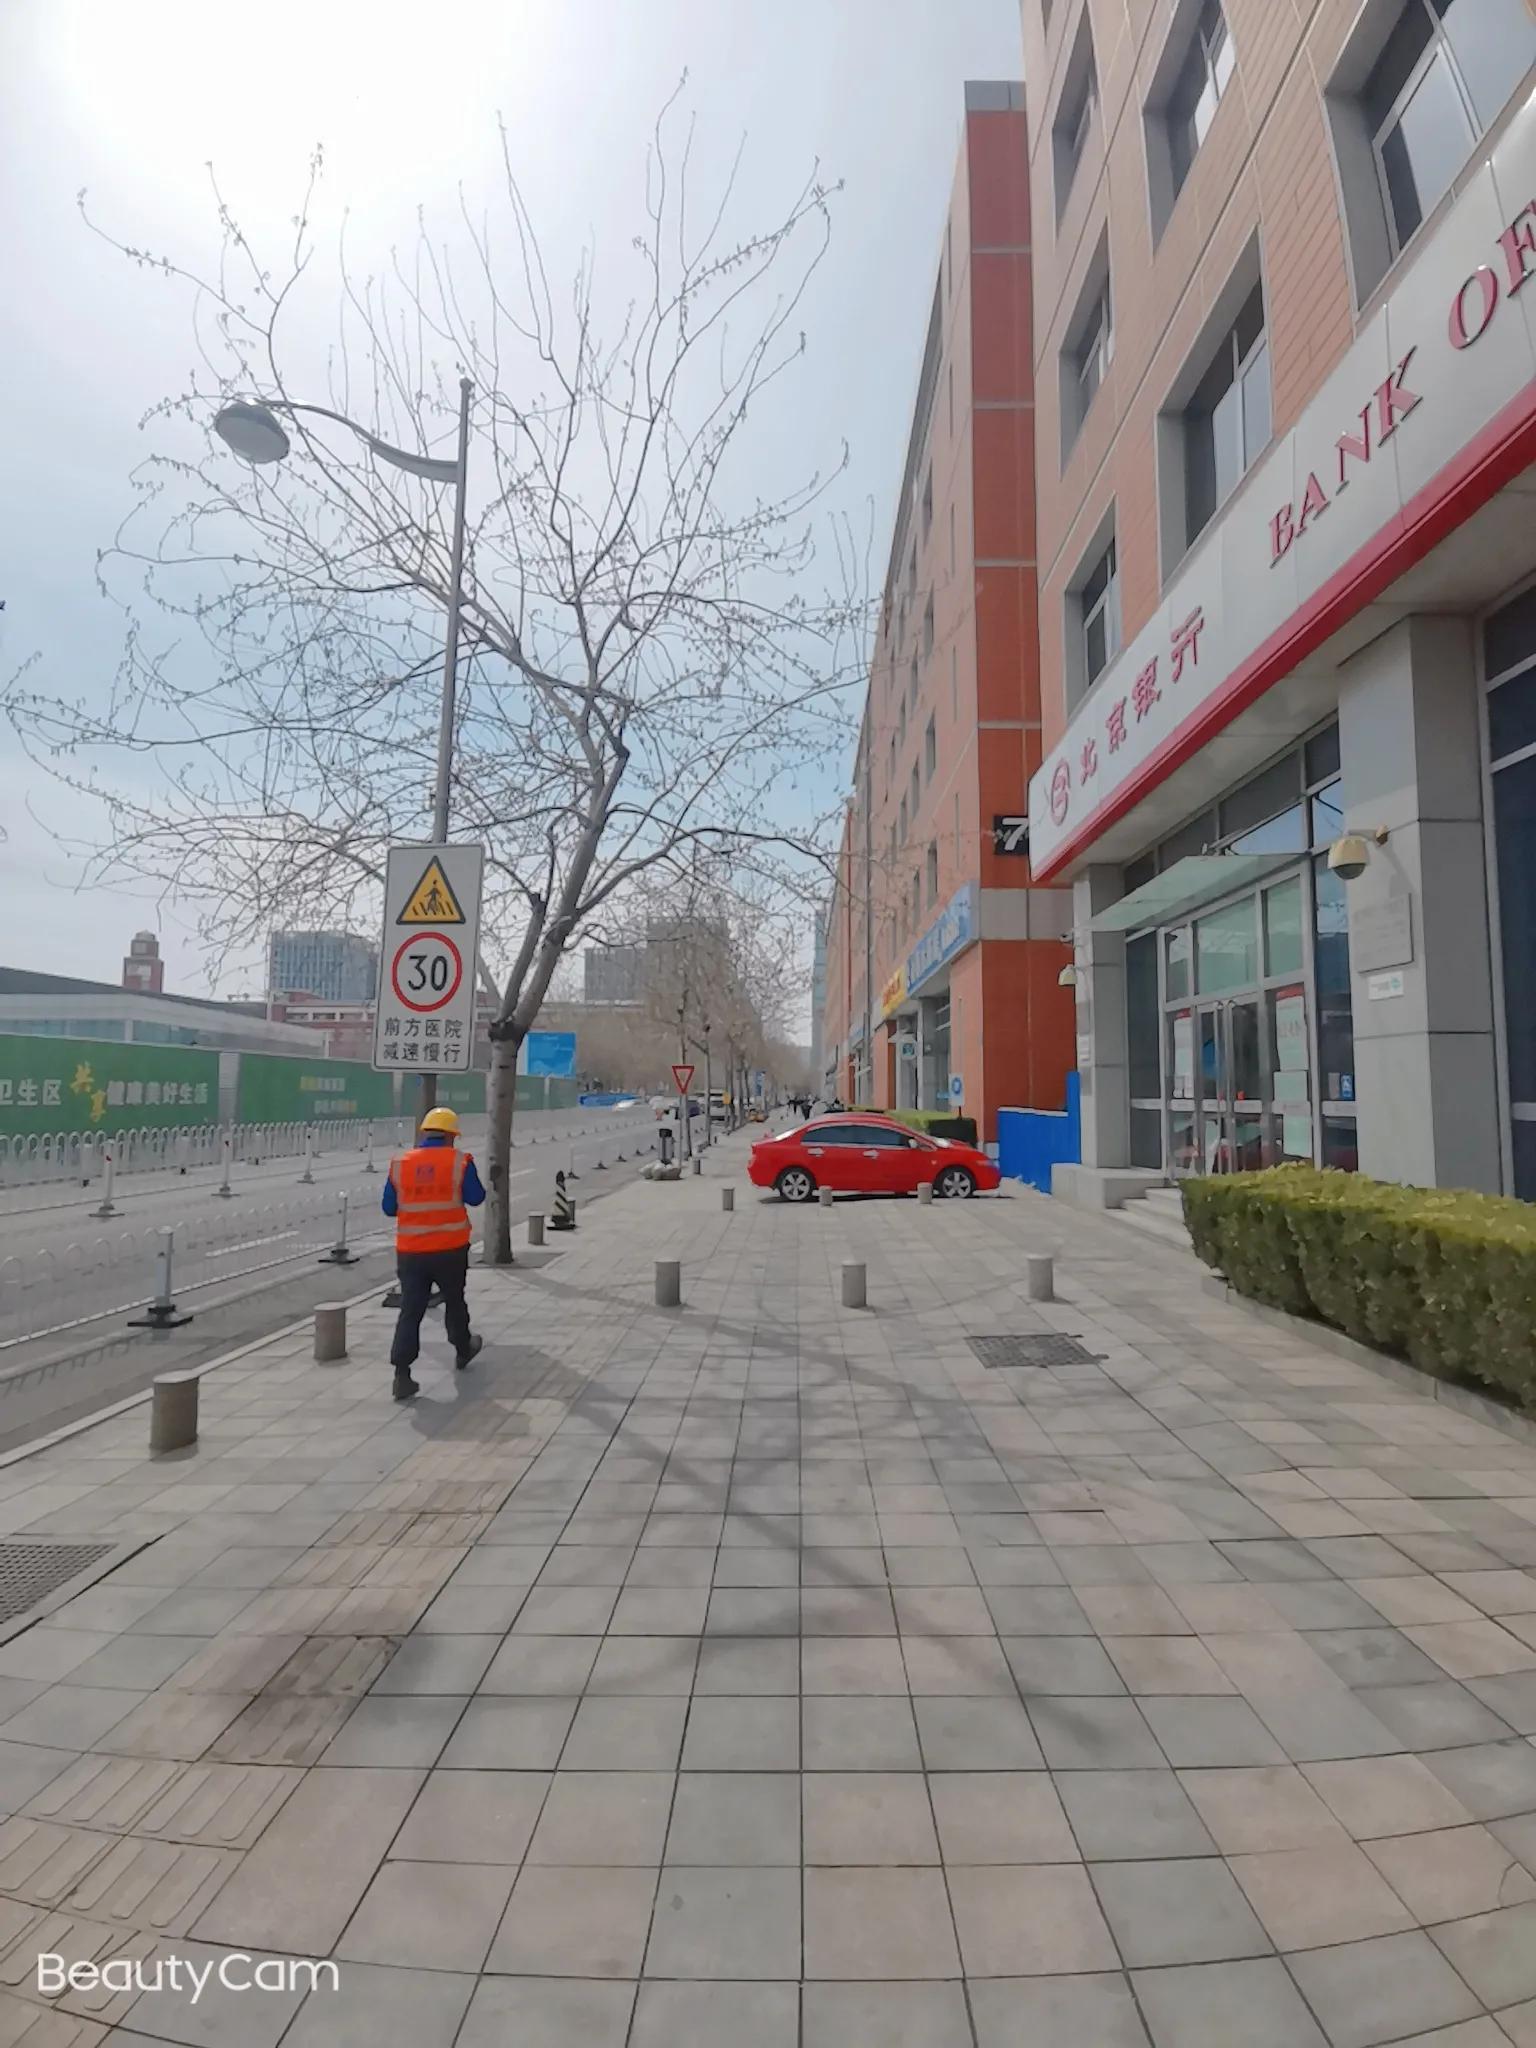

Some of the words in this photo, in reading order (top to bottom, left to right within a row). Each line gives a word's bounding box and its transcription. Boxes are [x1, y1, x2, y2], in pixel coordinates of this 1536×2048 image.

[1269, 345, 1423, 569] BANK
[1080, 606, 1205, 786] 北京银行
[408, 955, 447, 991] 30
[384, 1017, 463, 1039] 前方医院
[383, 1042, 461, 1063] 减速慢行
